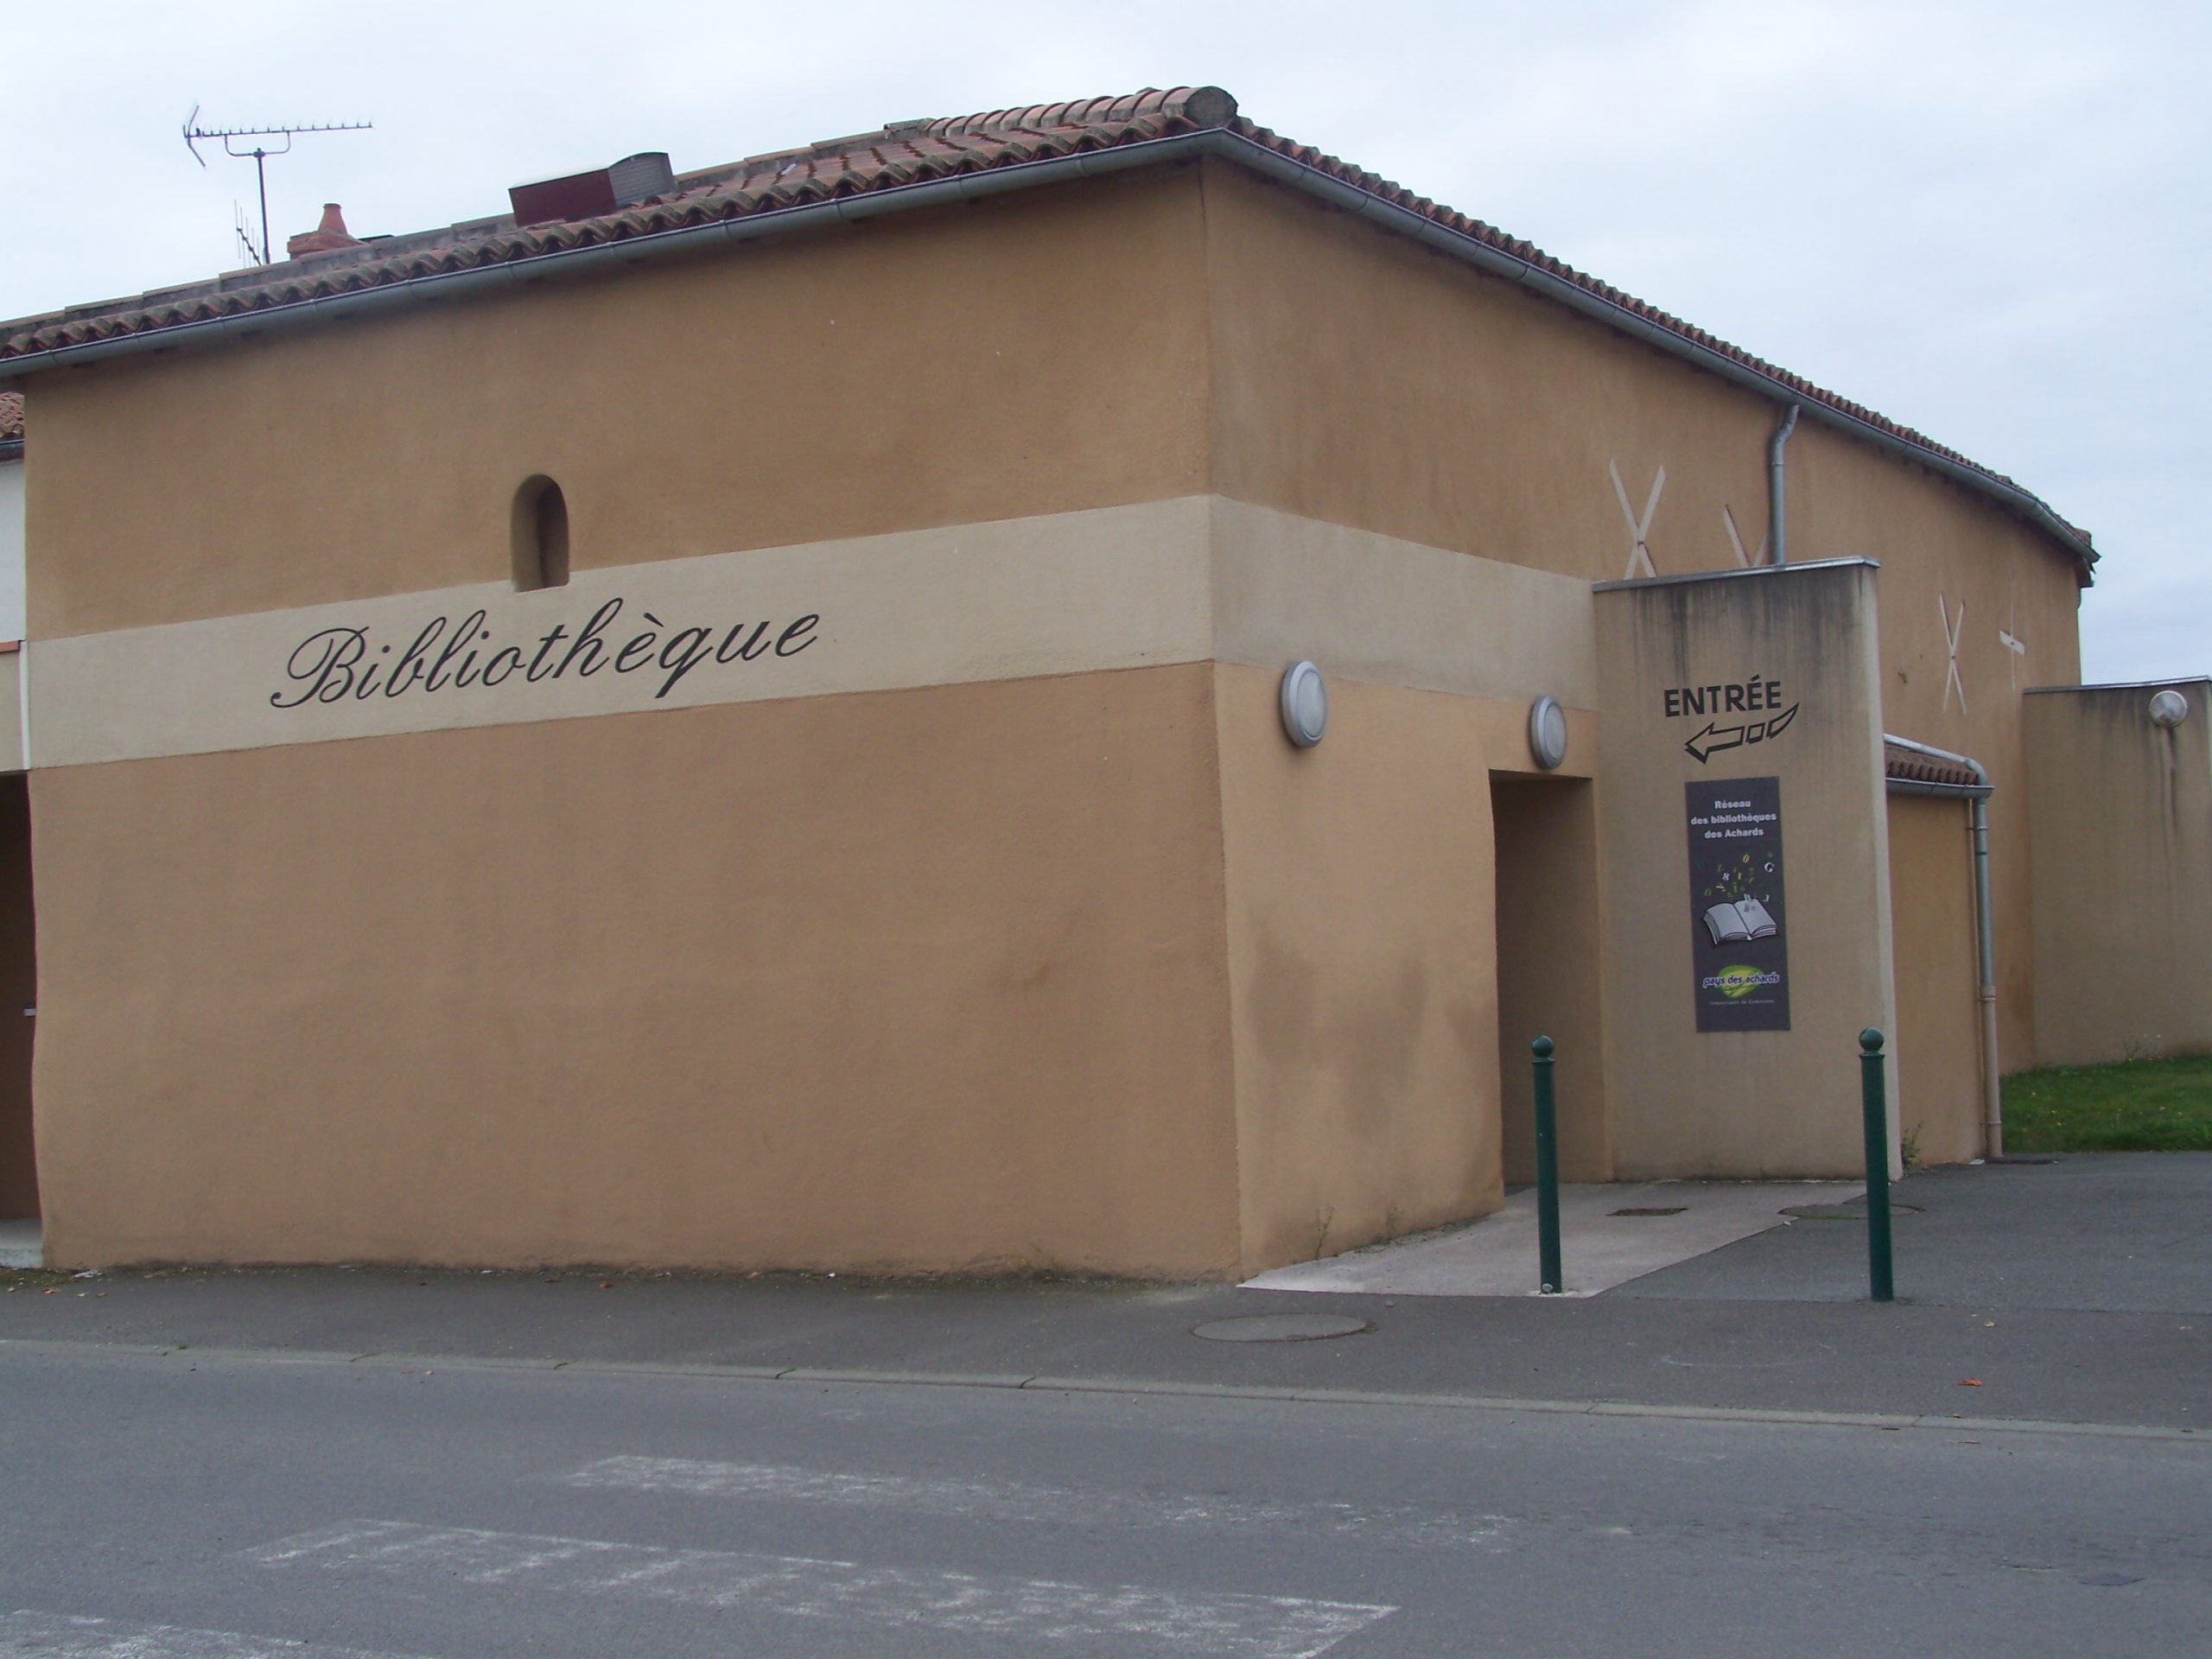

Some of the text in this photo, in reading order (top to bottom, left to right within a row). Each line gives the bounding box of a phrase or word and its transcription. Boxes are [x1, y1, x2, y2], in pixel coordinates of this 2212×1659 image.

[270, 597, 820, 709] Bibliothèque
[1663, 674, 1782, 717] ENTRÉE
[1714, 800, 1751, 810] Réseau
[1691, 813, 1777, 825] des bibliothèques
[1705, 828, 1764, 839] des Achards
[1703, 976, 1726, 988] pays
[1727, 975, 1743, 984] des
